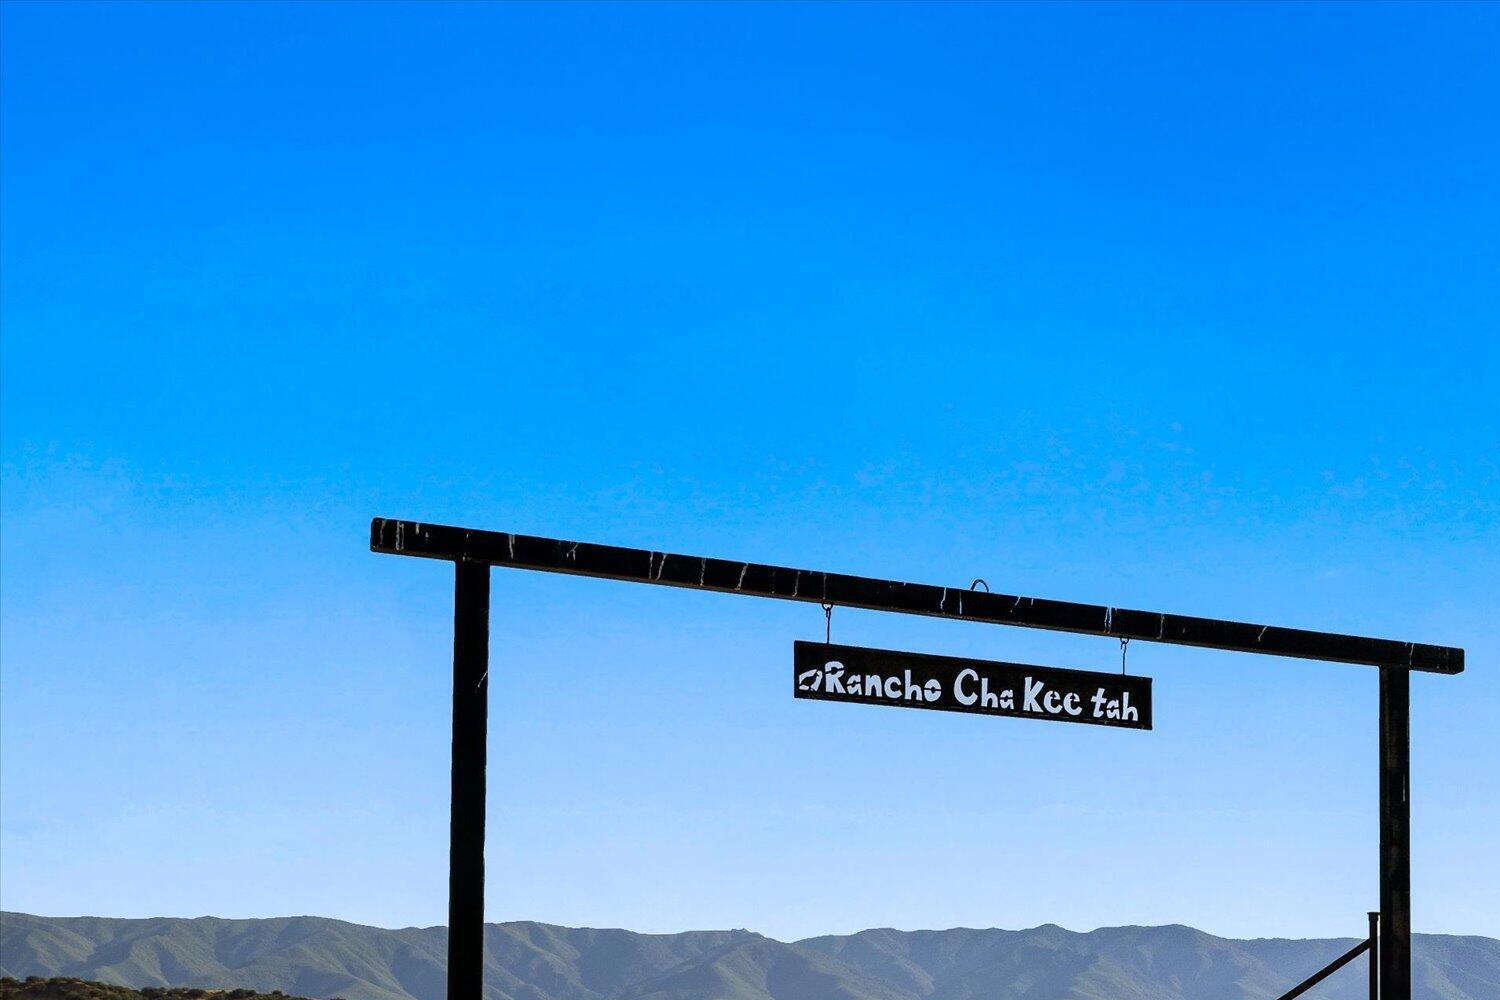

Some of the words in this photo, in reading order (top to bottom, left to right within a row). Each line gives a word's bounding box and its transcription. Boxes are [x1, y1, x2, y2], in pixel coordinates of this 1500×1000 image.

[824, 660, 942, 702] Rancho
[953, 668, 1015, 710] Cha
[1022, 676, 1083, 715] Kee
[1090, 687, 1139, 722] tah
